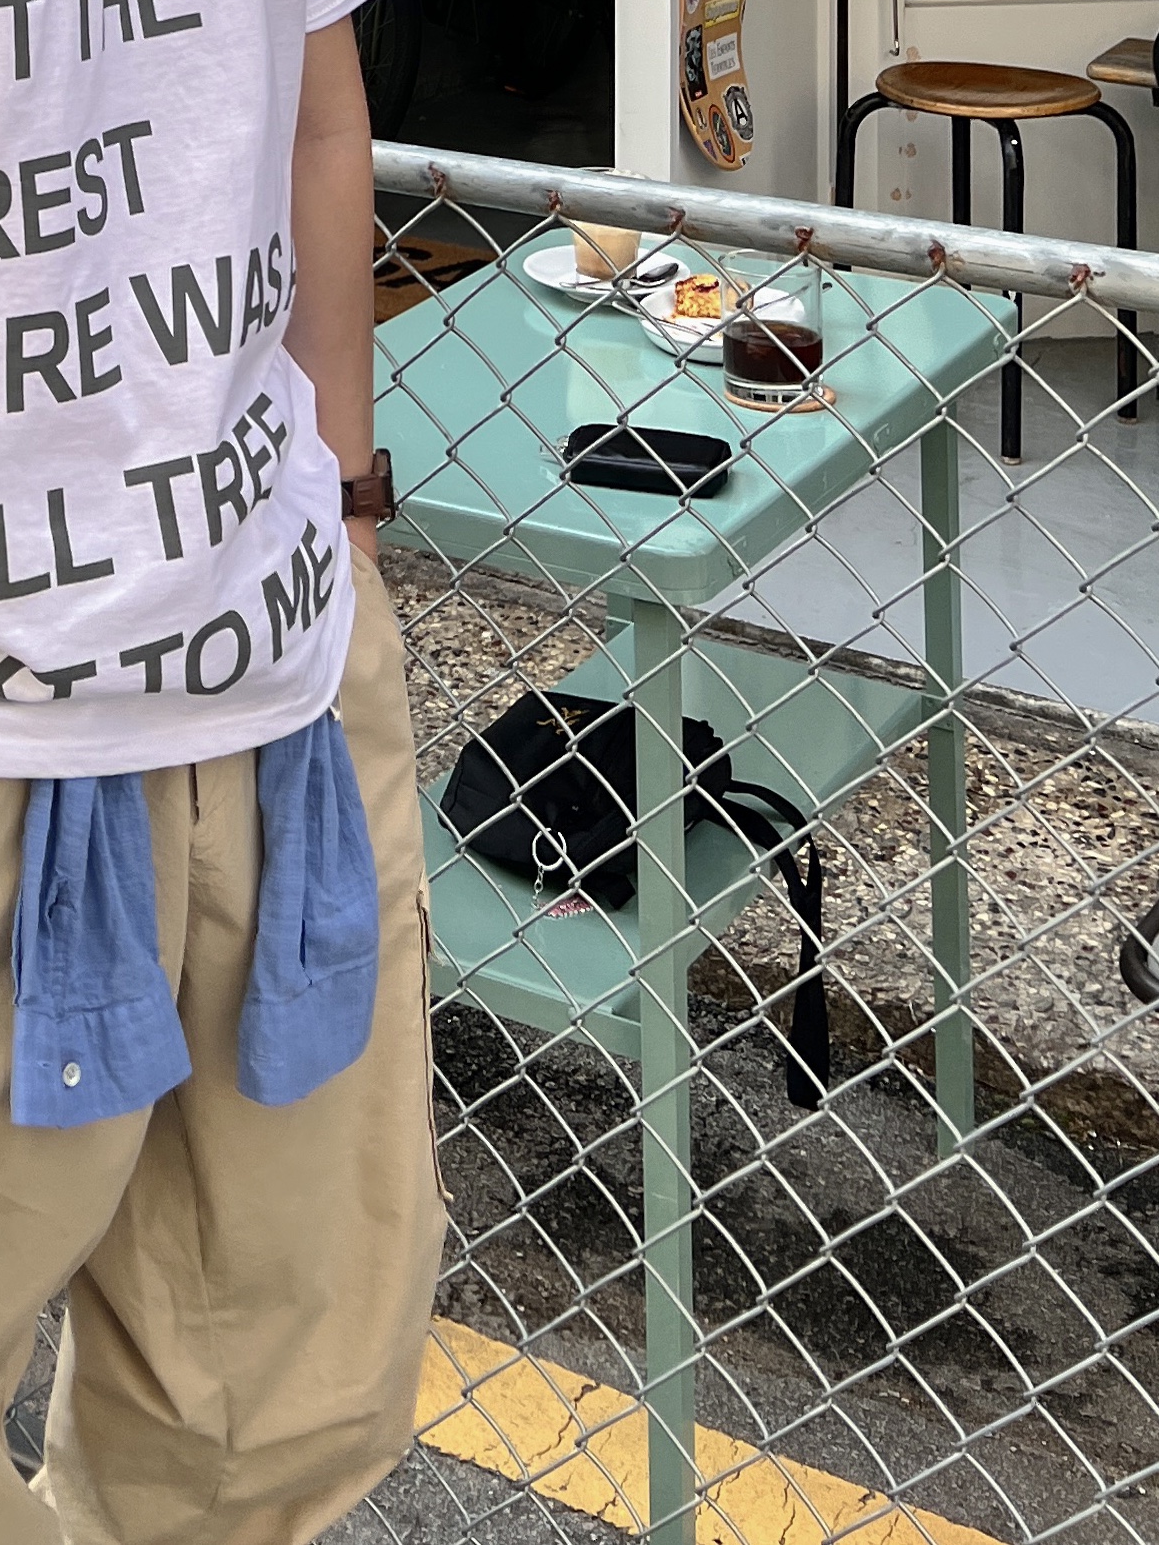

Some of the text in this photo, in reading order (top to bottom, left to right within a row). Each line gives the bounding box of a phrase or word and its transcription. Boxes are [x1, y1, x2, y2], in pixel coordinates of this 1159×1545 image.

[129, 232, 282, 366] WAS
[119, 609, 252, 696] TO
[260, 517, 335, 664] ME
